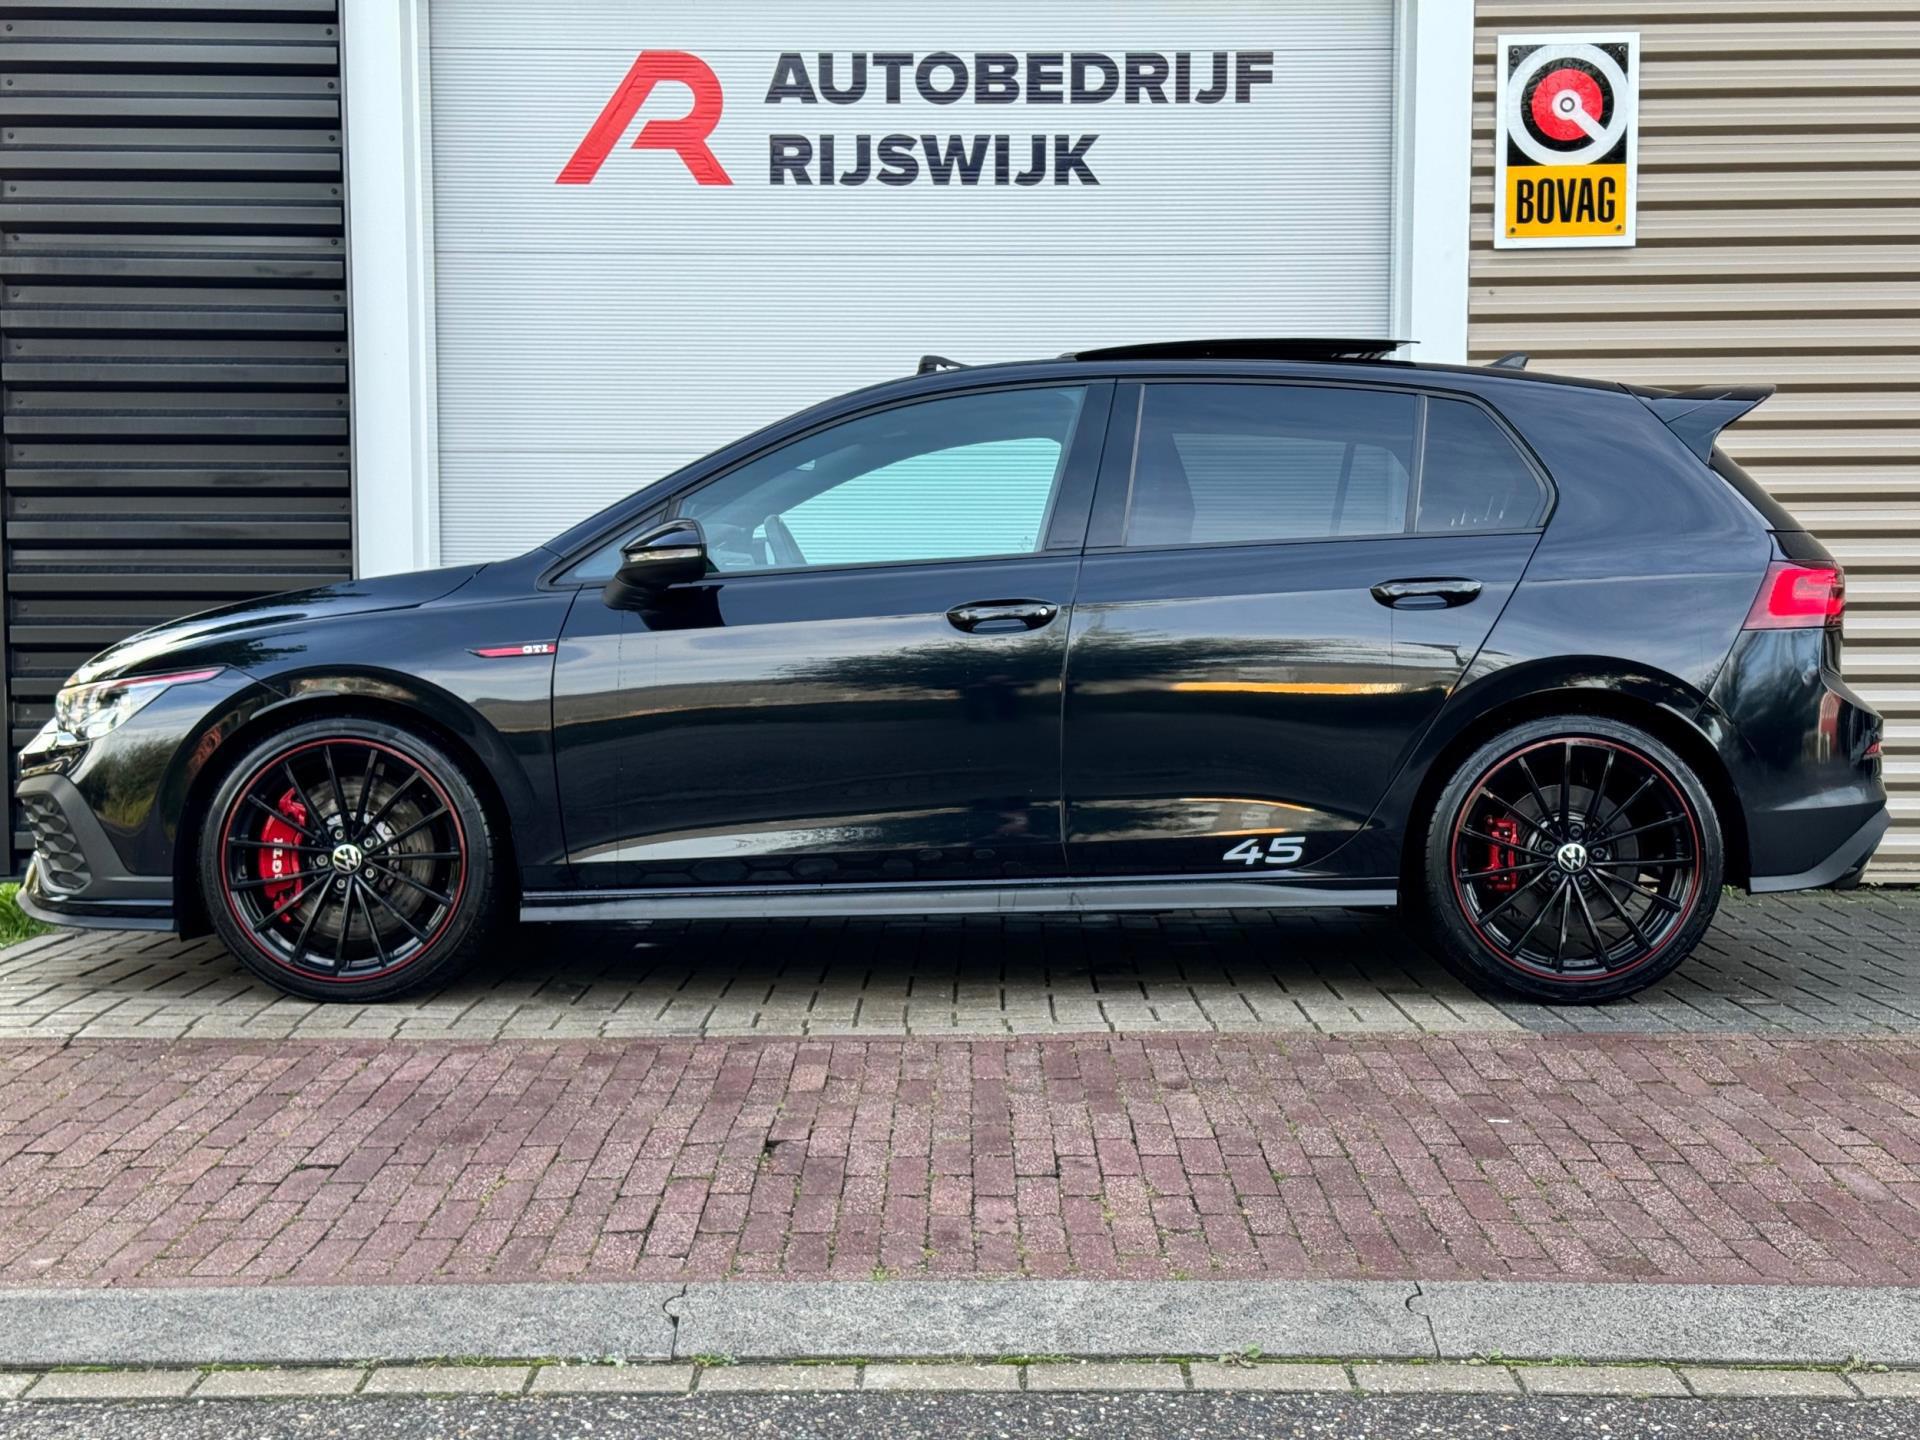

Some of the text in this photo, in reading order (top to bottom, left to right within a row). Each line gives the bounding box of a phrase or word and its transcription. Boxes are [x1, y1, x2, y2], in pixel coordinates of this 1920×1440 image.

[764, 51, 1275, 105] AUTOBEDRIJF
[769, 133, 1101, 186] RIJSWIJK
[1516, 176, 1616, 225] BOVAG
[522, 644, 549, 654] GTI
[1222, 836, 1306, 865] 45
[1557, 843, 1588, 873] VW
